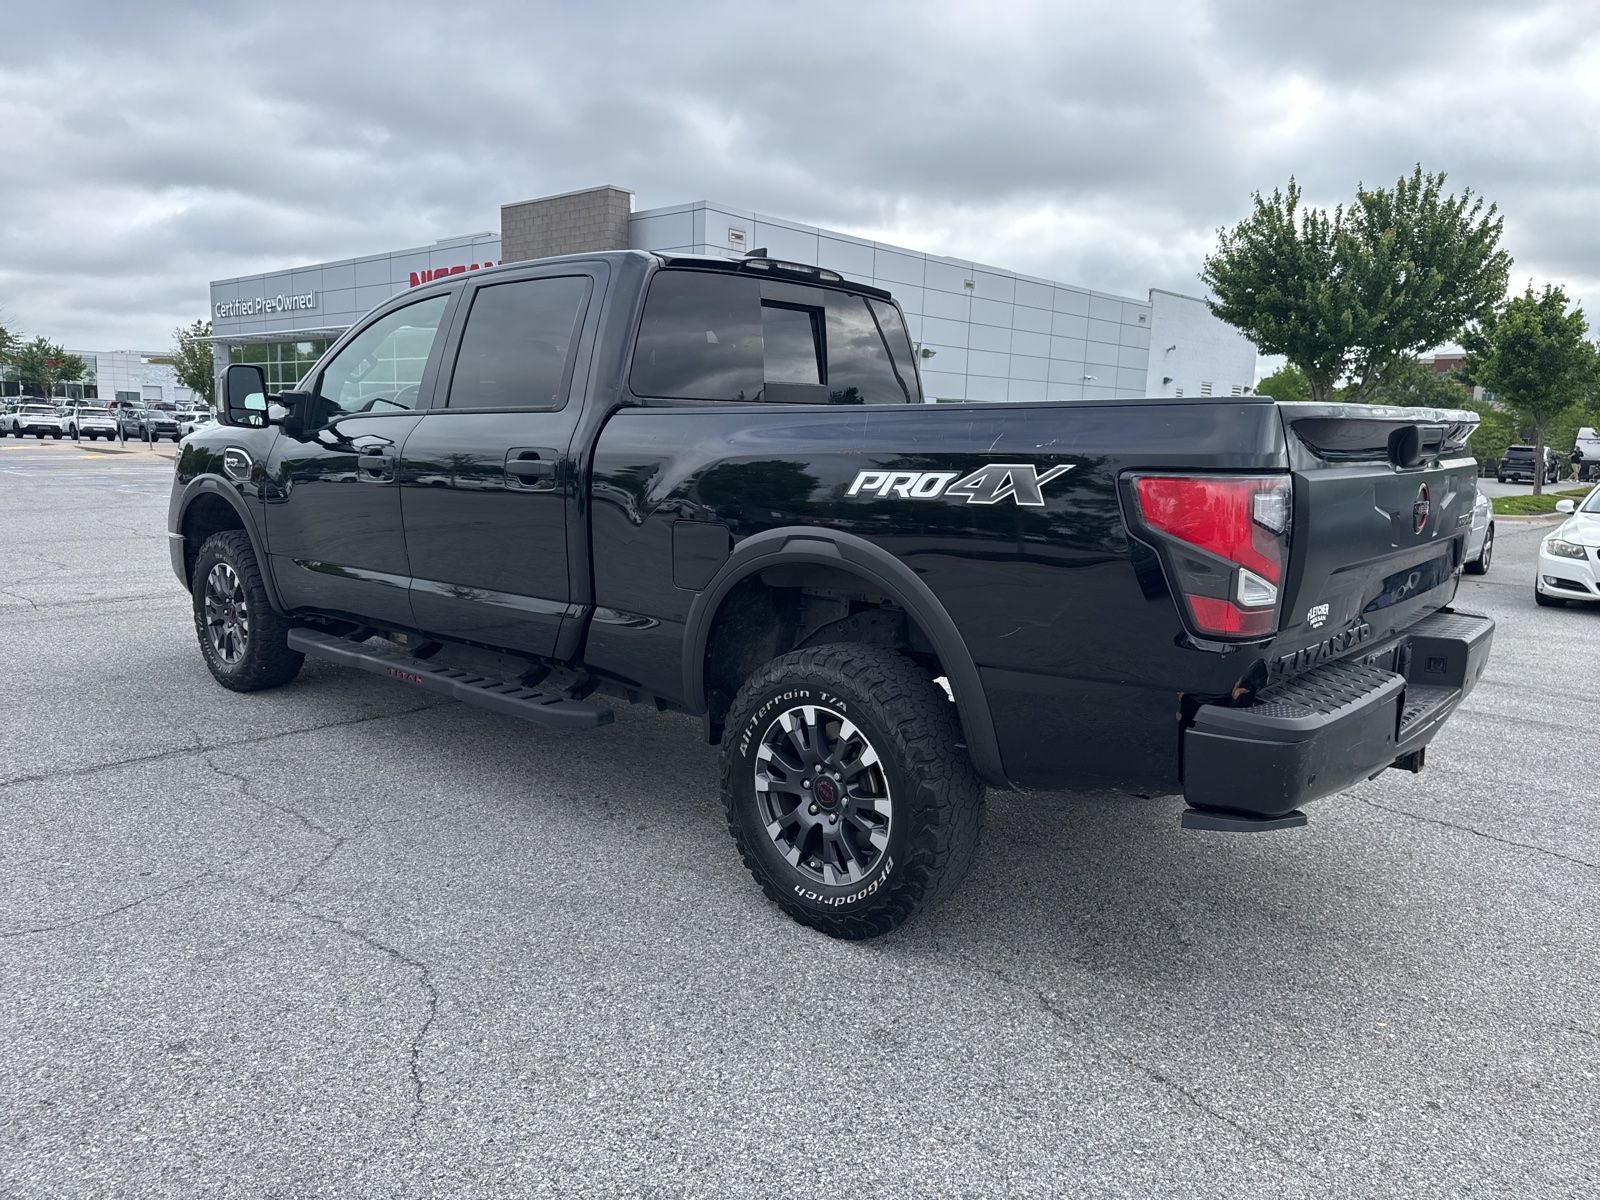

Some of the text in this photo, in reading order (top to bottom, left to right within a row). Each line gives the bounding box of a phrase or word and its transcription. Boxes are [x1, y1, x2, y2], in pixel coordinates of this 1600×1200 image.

[409, 260, 502, 288] NIS
[215, 290, 314, 318] Certified Pre-Owned
[739, 688, 848, 758] All-Terrain T/A
[794, 855, 894, 907] BFGoodrich
